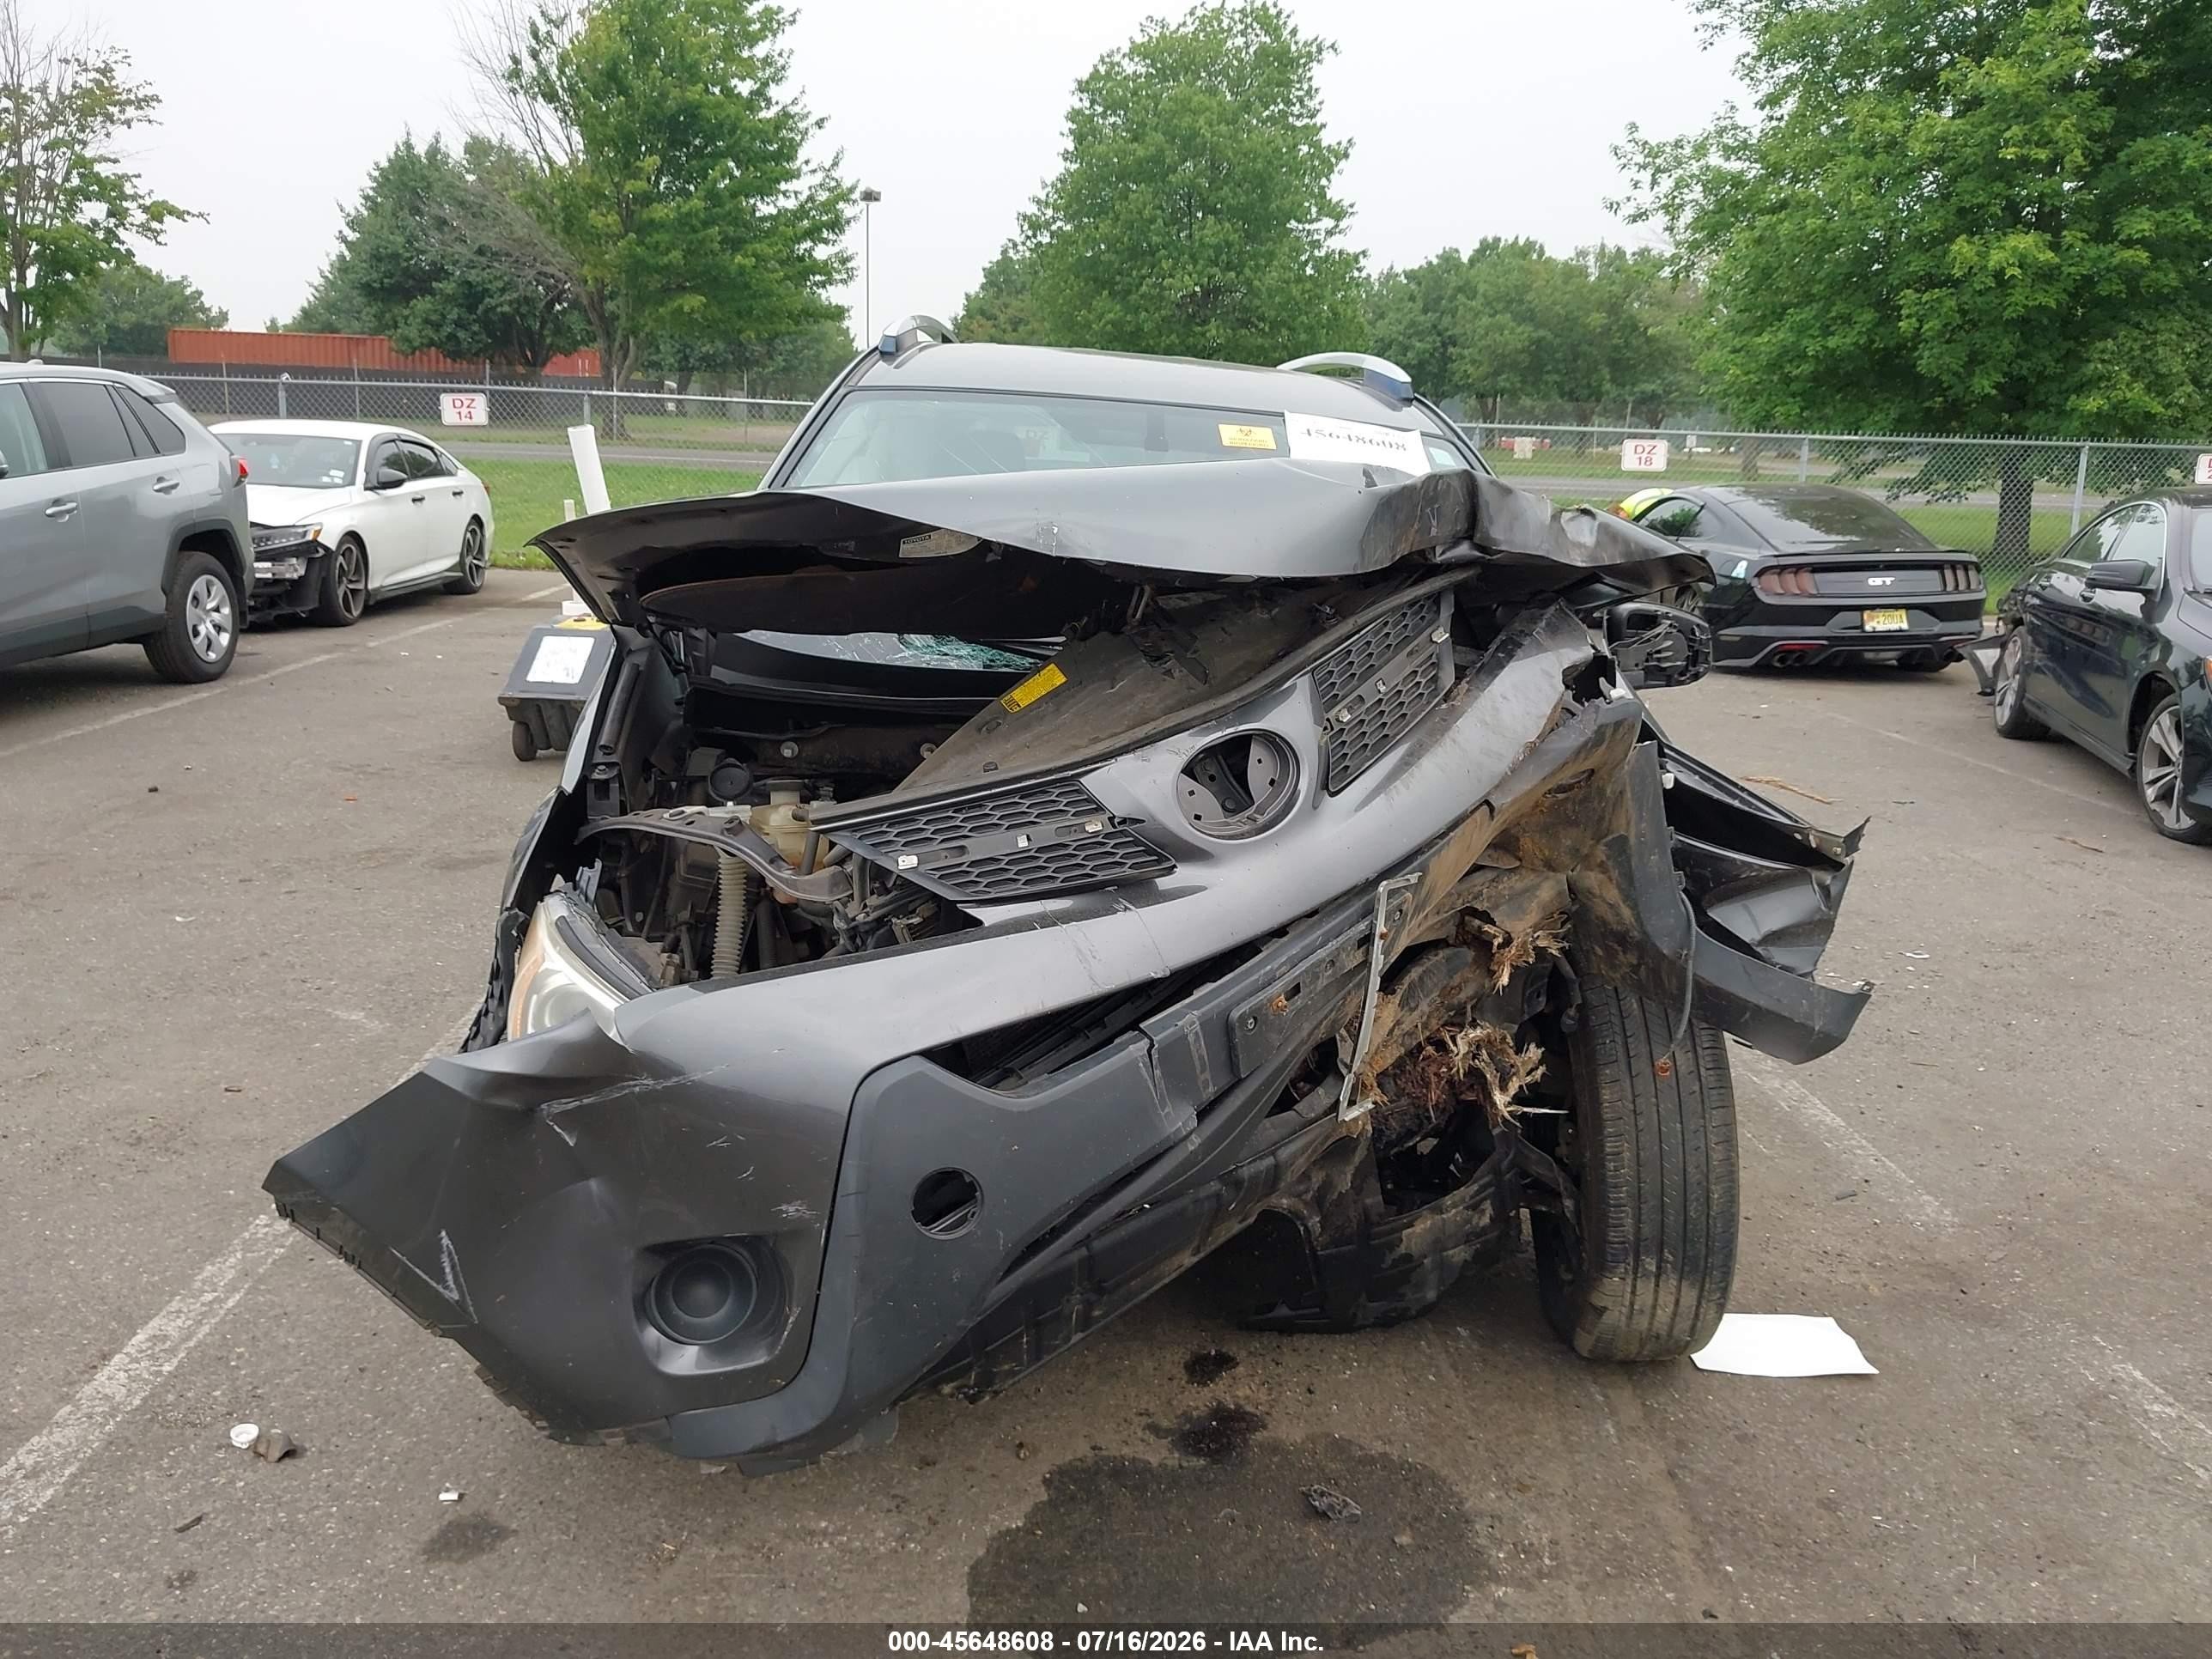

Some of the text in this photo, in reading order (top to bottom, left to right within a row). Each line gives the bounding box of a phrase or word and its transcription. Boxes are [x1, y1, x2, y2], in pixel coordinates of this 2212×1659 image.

[452, 398, 477, 410] DZ
[456, 410, 473, 422] 14
[1633, 444, 1657, 455] DZ
[1636, 456, 1653, 467] 18
[1867, 576, 1896, 586] GT
